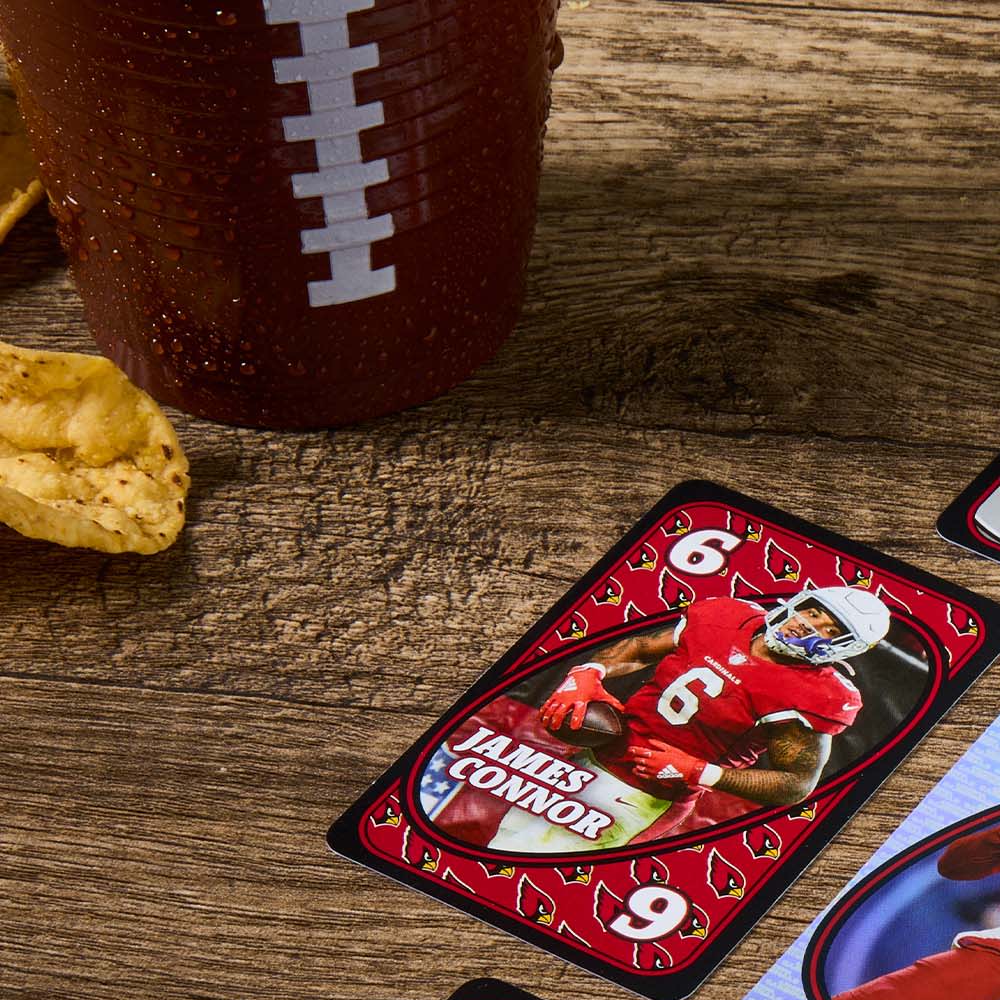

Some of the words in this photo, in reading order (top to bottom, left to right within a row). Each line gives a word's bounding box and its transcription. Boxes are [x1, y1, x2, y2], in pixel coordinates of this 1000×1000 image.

[667, 527, 743, 577] 6
[657, 666, 725, 727] 6
[703, 655, 743, 686] CARDINALS
[452, 725, 596, 794] JAMES
[447, 756, 613, 840] CONNOR
